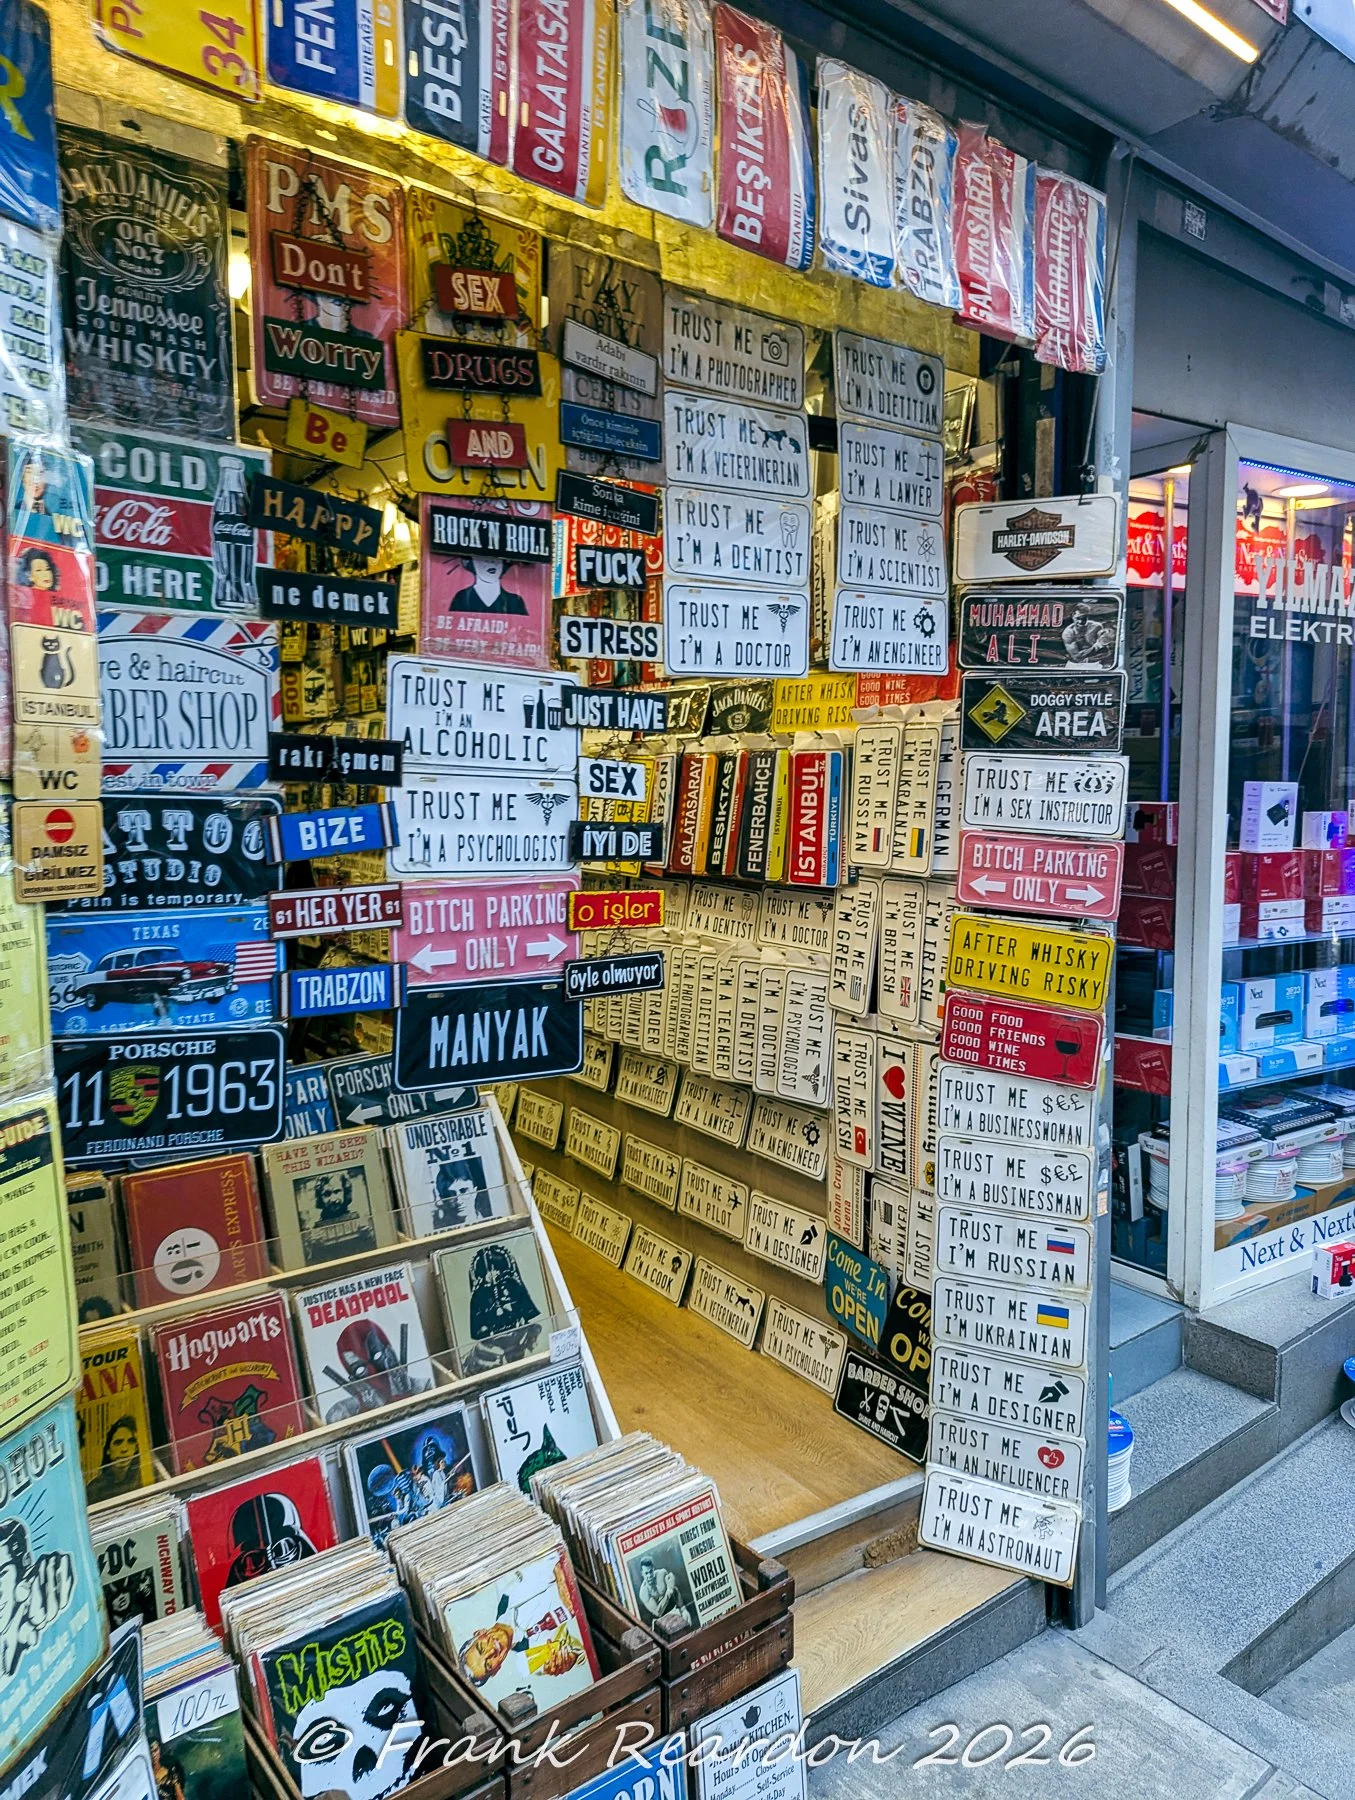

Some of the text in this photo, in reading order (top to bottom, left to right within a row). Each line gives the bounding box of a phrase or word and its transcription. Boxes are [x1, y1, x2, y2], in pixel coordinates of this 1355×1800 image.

[200, 10, 251, 89] 34
[843, 104, 872, 235] Sivas
[264, 160, 393, 244] PMS
[117, 221, 159, 246] Old
[964, 153, 994, 323] GALATASARAY
[281, 243, 365, 291] Don't
[451, 271, 505, 314] SEX
[76, 312, 138, 337] SOUR
[151, 328, 208, 352] MASH
[671, 308, 753, 355] TRUST ME
[64, 326, 218, 381] WHISKEY
[267, 323, 381, 380] Worry
[428, 351, 535, 387] DRUGS
[304, 411, 348, 453] Be
[466, 428, 515, 460] AND
[100, 441, 208, 491] COLD
[263, 488, 374, 546] HAPPY
[433, 513, 550, 557] ROCK'N ROLL
[674, 498, 765, 536] TRUST ME
[997, 530, 1071, 549] HARLEY-DAVIDSON
[122, 564, 203, 602] HERE
[580, 551, 644, 587] FUCK
[272, 585, 390, 615] ne demek
[969, 602, 1065, 628] MUHAMMAD
[436, 615, 509, 634] BE AFRAID!
[566, 620, 659, 658] STRESS
[986, 634, 1041, 664] ALI
[156, 653, 246, 687] haircut
[22, 697, 96, 719] İSTANBUL
[565, 693, 666, 730] JUST HAVE
[1030, 692, 1113, 707] DOGGY STYLE
[178, 688, 259, 751] SHOP
[1034, 711, 1108, 738] AREA
[279, 746, 323, 768] rakı
[403, 726, 549, 764] ALCOHOLIC
[39, 770, 80, 791] WC
[407, 790, 518, 821] TRUST ME
[680, 759, 702, 867] GALATASARAY
[712, 757, 735, 865] BEŞİKTAŞ
[747, 756, 772, 873] FENERBAHÇE
[794, 759, 819, 878] İSTANBUL
[829, 796, 838, 843] TÜRKİYE
[892, 769, 914, 860] UKRAINIAN
[973, 794, 1113, 825] I'M A SEX INSTRUCTOR
[30, 844, 90, 859] DAMSIZ
[298, 816, 366, 851] BİZE
[582, 825, 653, 857] İYİ DE
[972, 844, 1108, 879] BITCH PARKING
[120, 890, 246, 907] is temporary.
[275, 893, 400, 928] 61 HER YER 61
[409, 892, 568, 936] BITCH PARKING
[603, 899, 655, 925] işler
[132, 924, 181, 941] TEXAS
[792, 926, 829, 948] DOCTOR
[963, 930, 1101, 972] AFTER WHISKY
[464, 935, 519, 972] ONLY
[833, 929, 851, 993] GREEK
[884, 929, 898, 994] BRITISH
[297, 971, 386, 1010] TRABZON
[570, 962, 660, 993] öyle olmuyor
[954, 957, 1101, 1000] DRIVING RISKY
[647, 992, 662, 1045] TRADER
[951, 1019, 1046, 1047] GOOD FRIENDS
[952, 1005, 1024, 1028] GOOD FOOD
[108, 1040, 217, 1061] PORSCHE
[429, 1006, 550, 1071] MANYAK
[716, 1010, 731, 1073] TEACHER
[737, 1012, 756, 1078] DENTIST
[950, 1033, 1020, 1057] GOOD WINE
[948, 1046, 1027, 1073] GOOD TIMES
[164, 1058, 277, 1120] 1963
[703, 1113, 735, 1137] LAWYER
[836, 1075, 852, 1151] TURKISH
[86, 1128, 225, 1155] FERDINAND PORSCHE
[313, 1142, 336, 1156] YOU
[405, 1114, 488, 1151] UNDESIRABLE
[880, 1101, 907, 1175] WINE
[283, 1161, 312, 1175] THIS
[777, 1138, 821, 1172] ENGINEER
[219, 1169, 242, 1237] EXPRESS
[706, 1205, 732, 1229] PILOT
[773, 1235, 819, 1274] DESIGNER
[948, 1244, 1075, 1283] I'M RUSSIAN
[1240, 1236, 1285, 1273] Next
[1290, 1226, 1306, 1252] &
[303, 1288, 338, 1307] JUSTICE
[338, 1282, 357, 1298] HAS
[365, 1274, 384, 1290] NEW
[383, 1267, 405, 1285] FACE
[828, 1239, 886, 1301] Come In
[307, 1282, 410, 1329] DEADPOOL
[832, 1285, 880, 1345] OPEN
[166, 1311, 282, 1373] Hogwarts
[782, 1341, 834, 1388] PSYCHOLOGIST
[847, 1362, 898, 1397] BARBER
[700, 1516, 717, 1536] FROM
[932, 1512, 1063, 1574] I'M AN ASTRONAUT
[156, 1534, 176, 1595] HIGHWAY
[690, 1555, 727, 1589] WORLD
[171, 1689, 229, 1738] 100 TL
